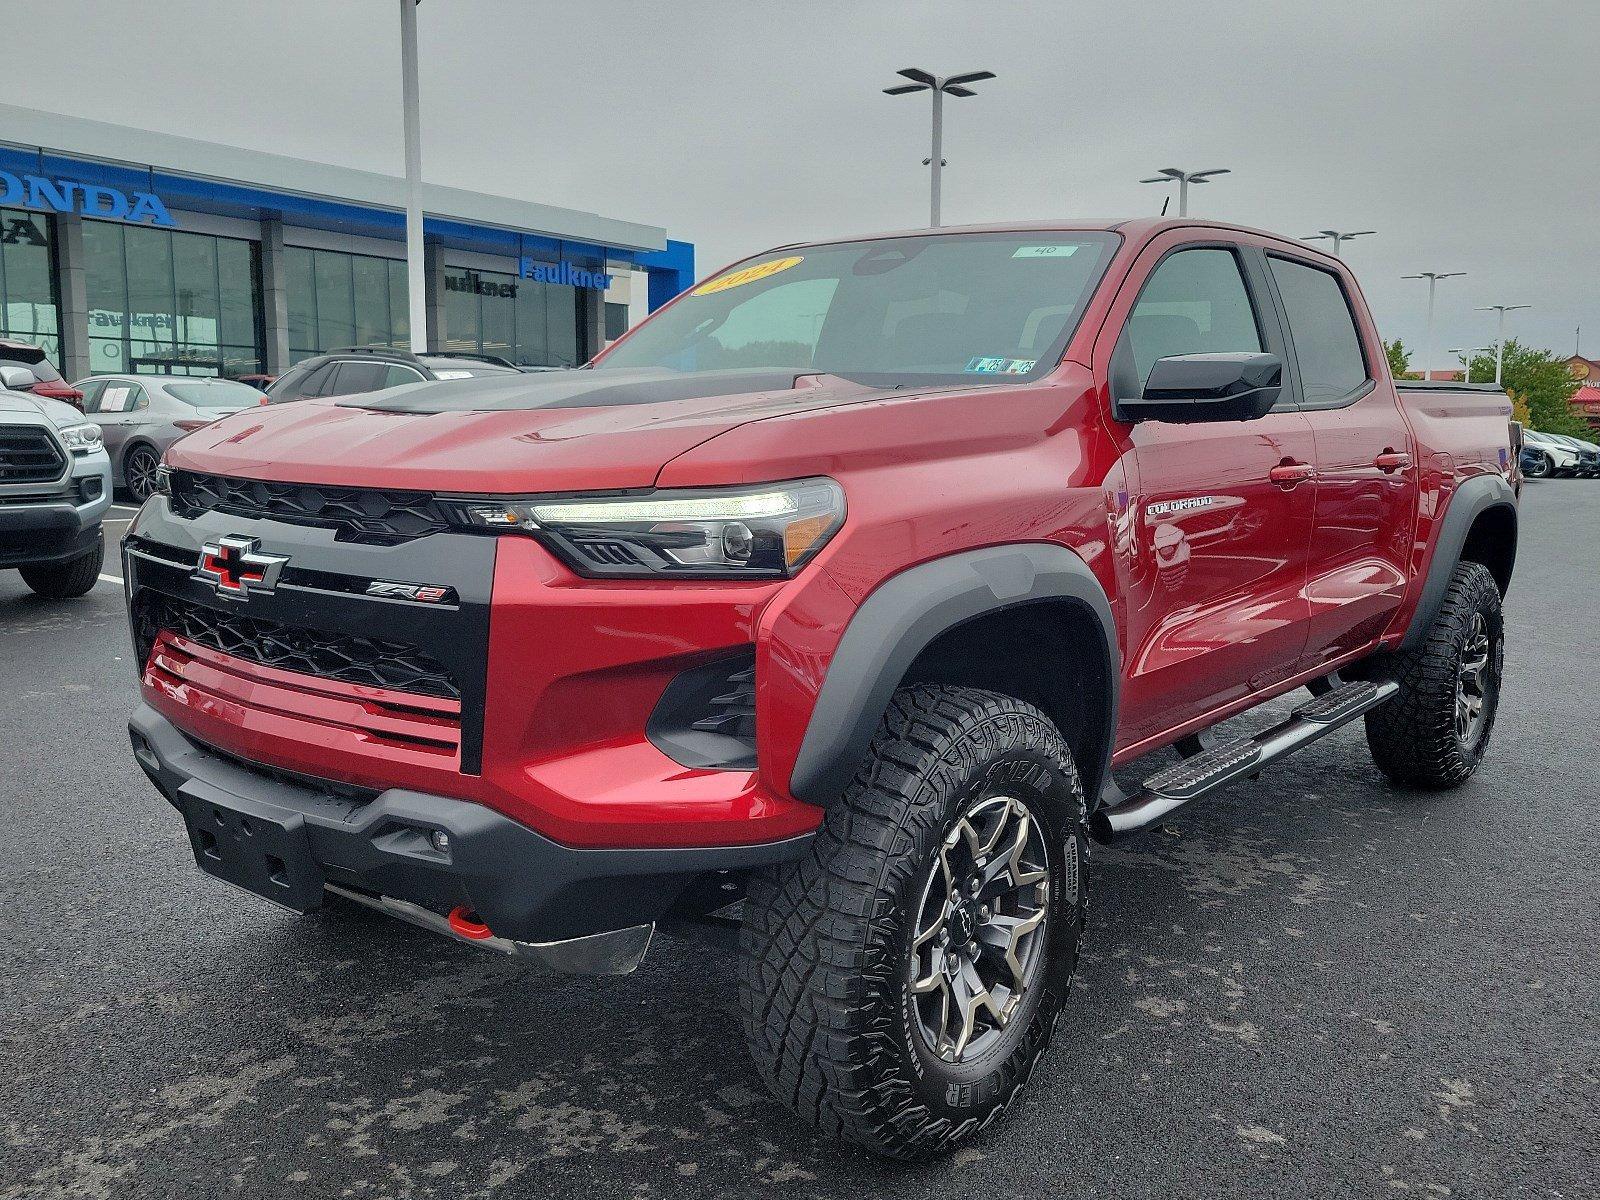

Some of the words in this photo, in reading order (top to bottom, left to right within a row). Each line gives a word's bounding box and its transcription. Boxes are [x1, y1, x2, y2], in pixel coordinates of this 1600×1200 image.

[519, 255, 613, 290] Faulkner
[1147, 495, 1213, 515] COLORADO
[366, 581, 446, 602] ZR2
